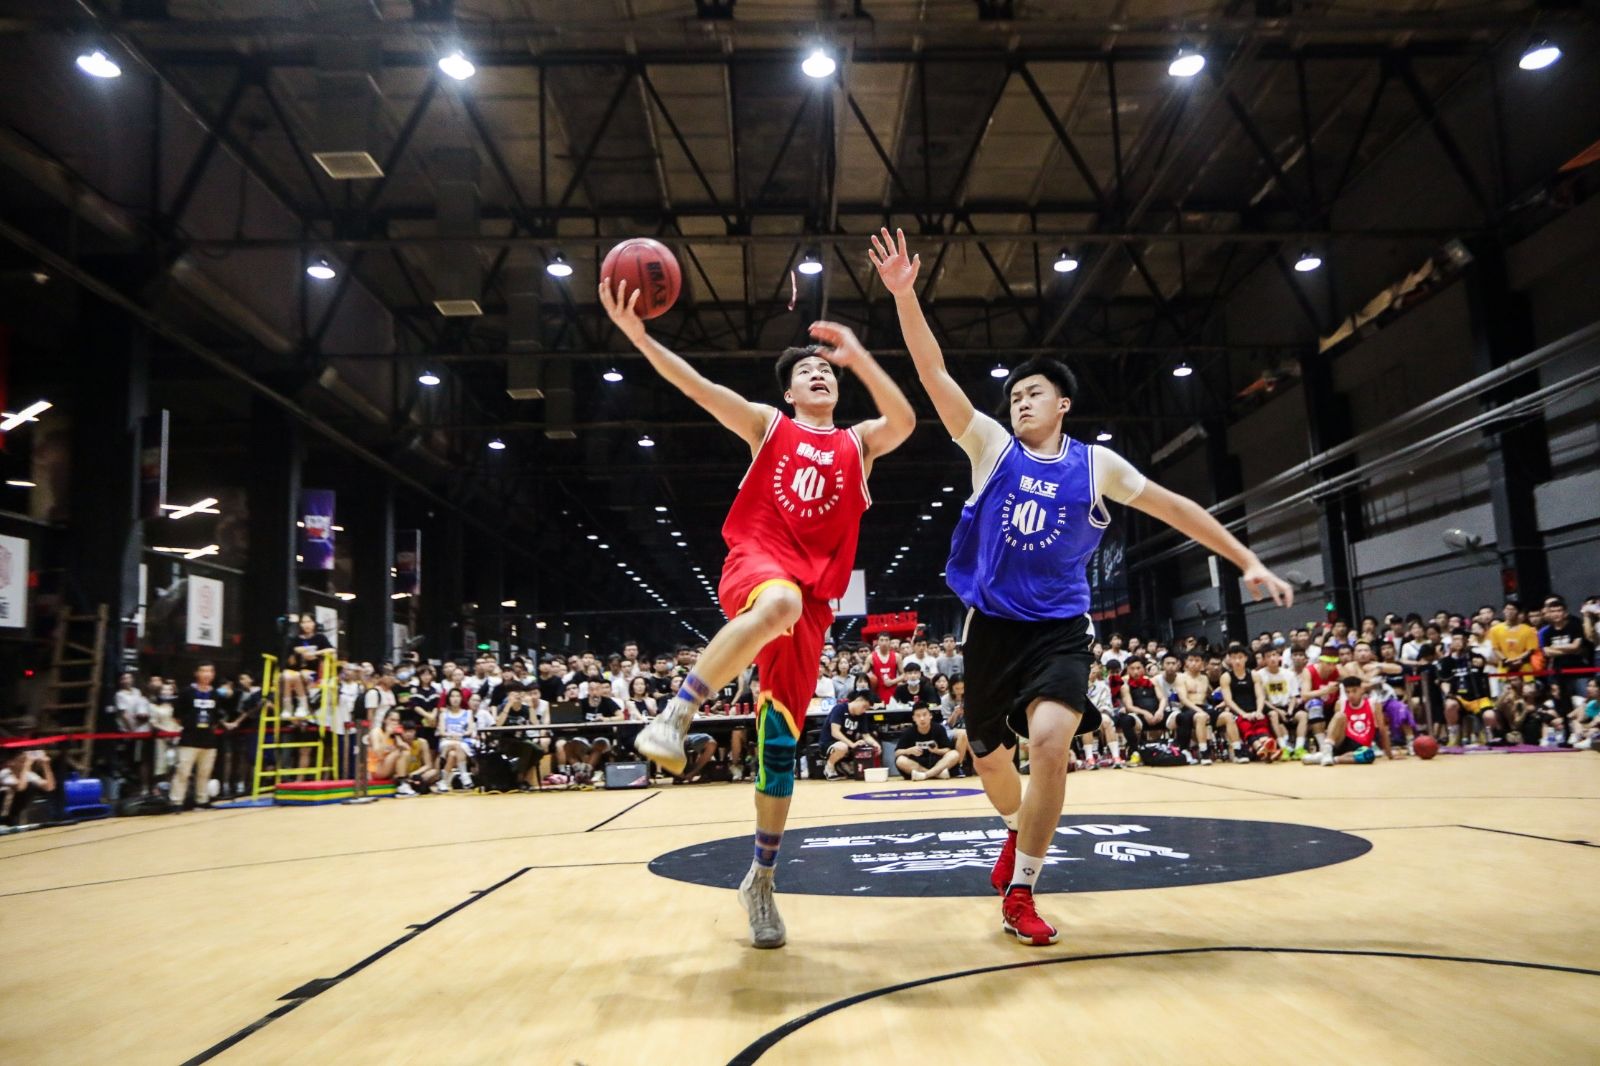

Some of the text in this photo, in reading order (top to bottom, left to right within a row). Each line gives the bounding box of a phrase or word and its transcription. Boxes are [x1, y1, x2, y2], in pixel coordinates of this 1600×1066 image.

[800, 508, 813, 518] OF
[1057, 505, 1067, 525] THE
[1039, 528, 1061, 549] KING
[1022, 543, 1034, 551] OF
